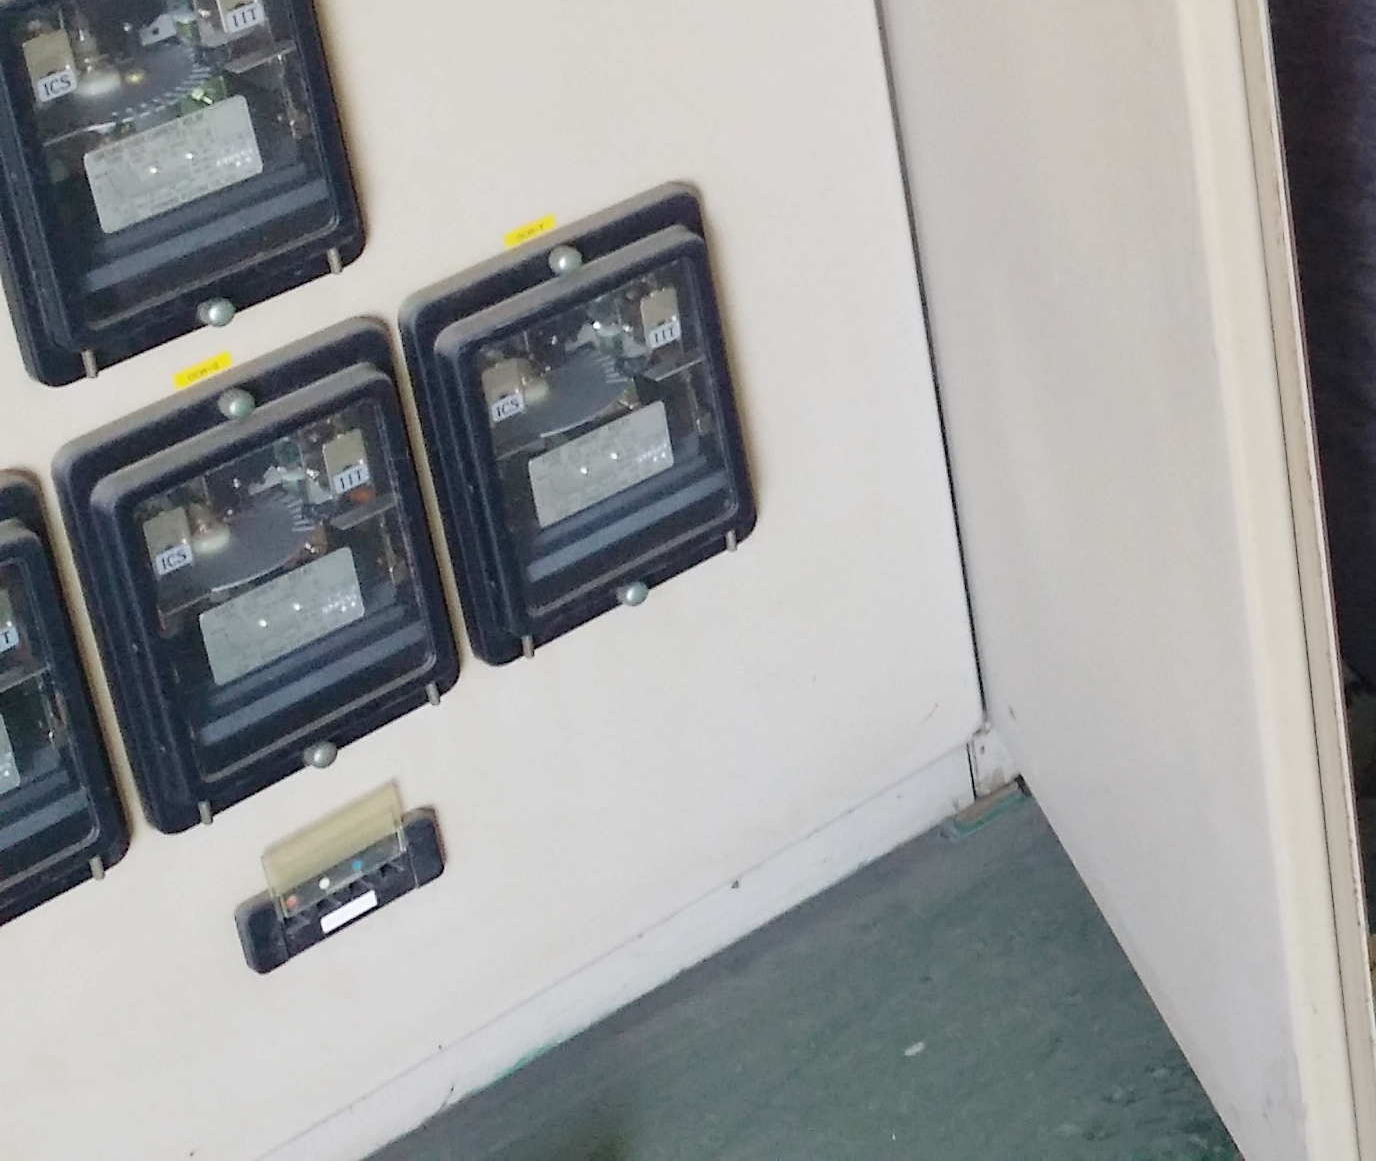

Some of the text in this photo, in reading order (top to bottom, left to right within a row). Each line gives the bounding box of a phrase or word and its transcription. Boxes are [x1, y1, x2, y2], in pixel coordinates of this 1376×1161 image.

[43, 76, 72, 97] ICS
[495, 397, 520, 418] ICS
[160, 550, 188, 571] ICS
